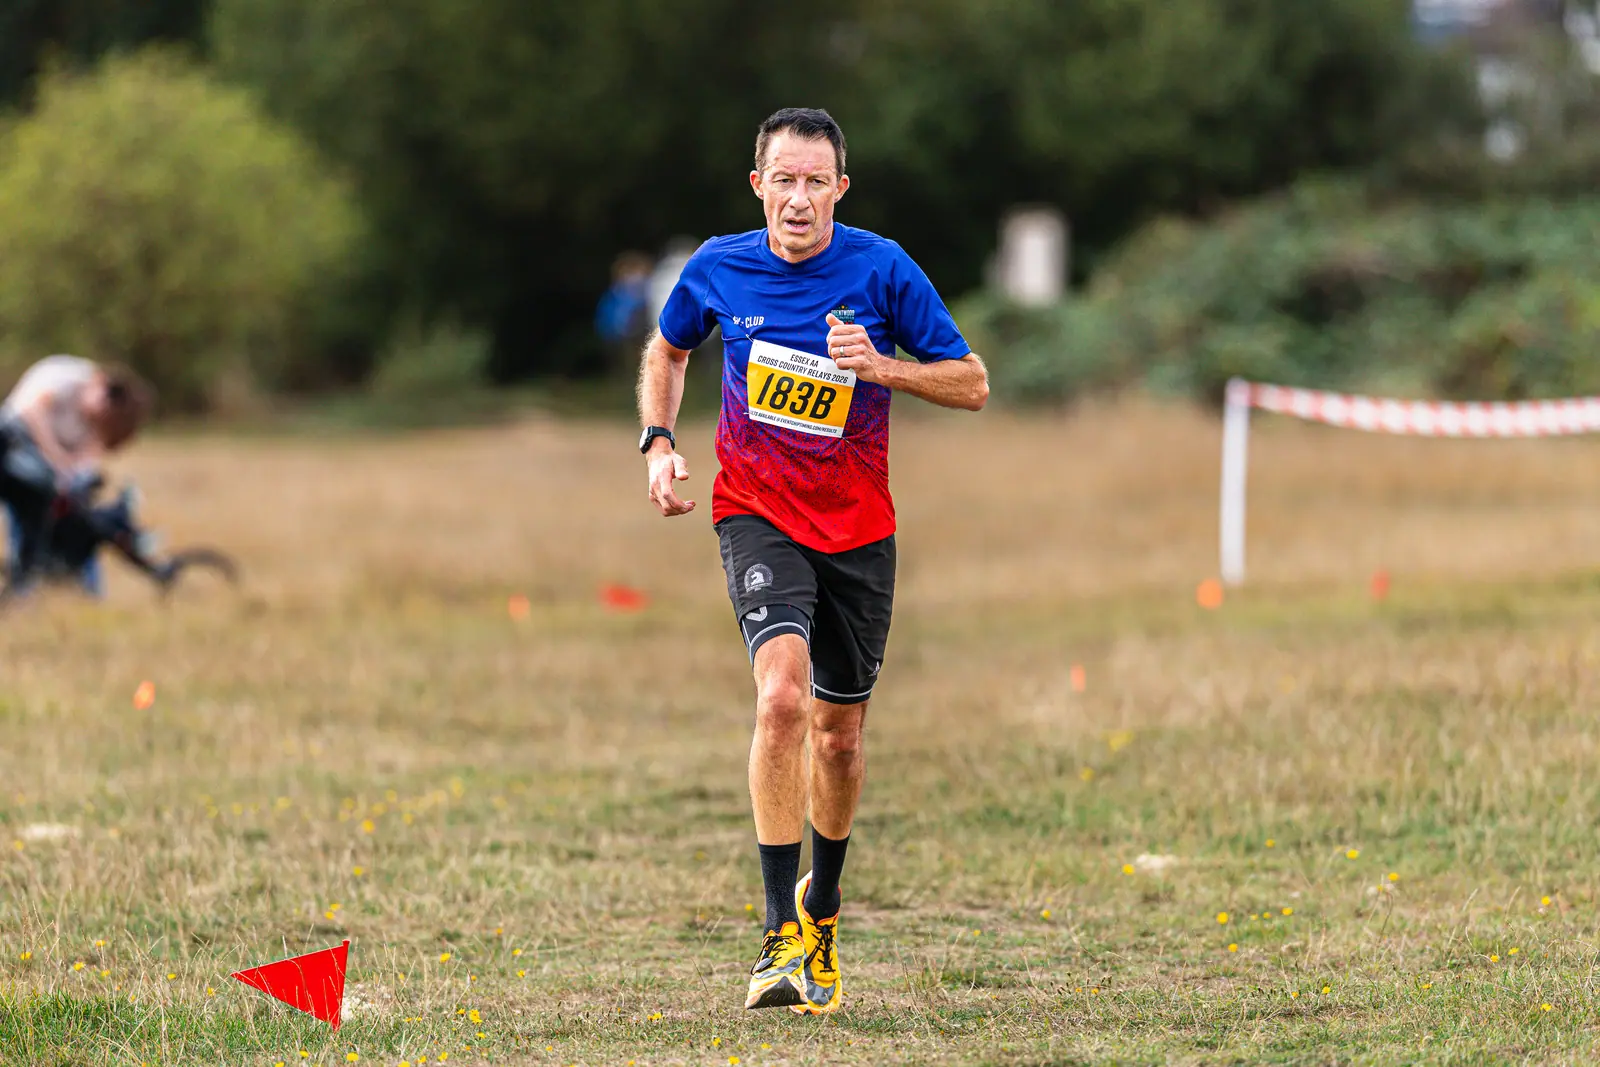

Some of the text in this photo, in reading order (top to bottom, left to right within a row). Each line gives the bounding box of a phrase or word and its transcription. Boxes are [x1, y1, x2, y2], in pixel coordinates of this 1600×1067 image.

[757, 355, 849, 384] CROSS COUNTRY RELAYS 2026
[790, 354, 819, 368] ESSEX AA
[756, 372, 837, 420] 183B
